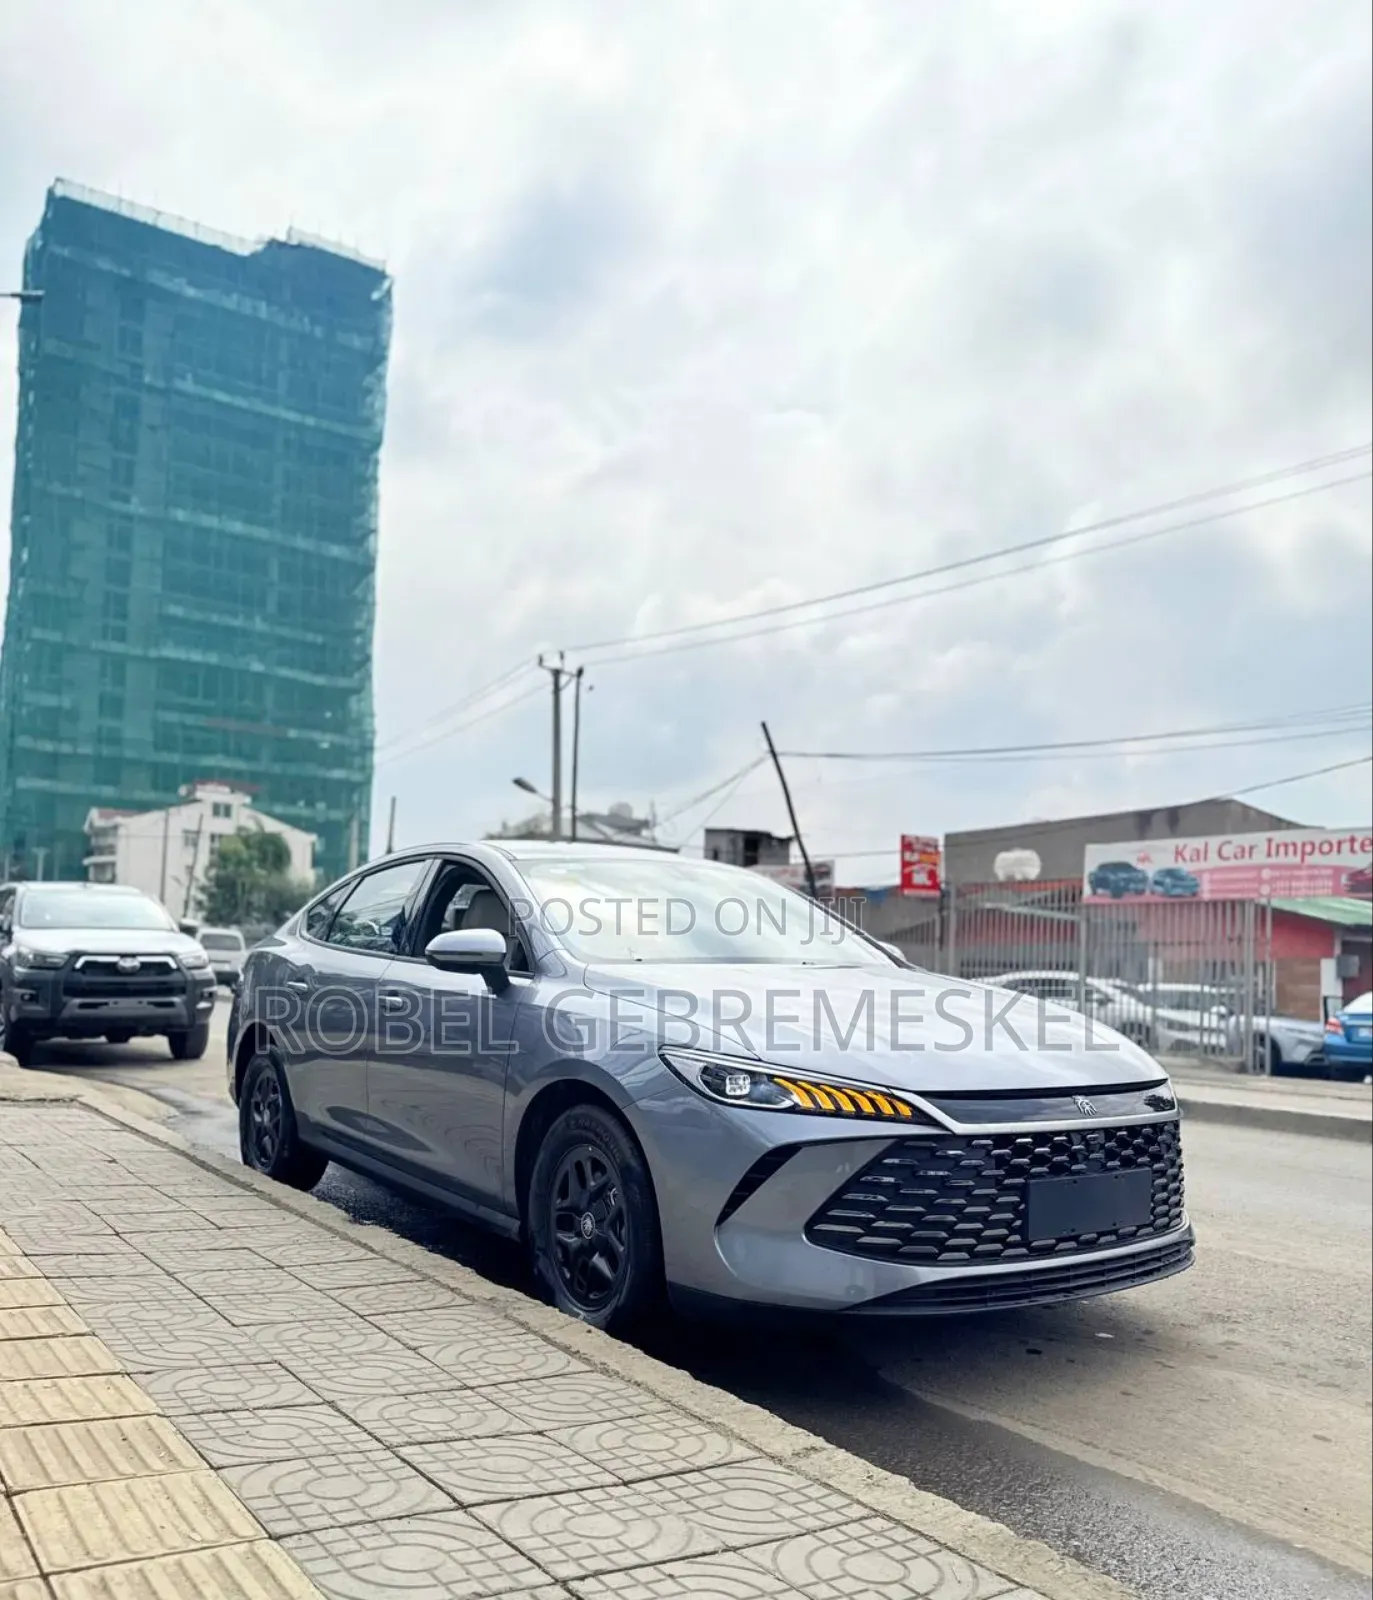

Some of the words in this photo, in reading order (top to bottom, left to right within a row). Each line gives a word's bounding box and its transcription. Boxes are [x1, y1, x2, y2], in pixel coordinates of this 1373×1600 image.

[1174, 842, 1208, 863] Kal
[1217, 841, 1258, 861] Car
[1265, 834, 1372, 863] Importe
